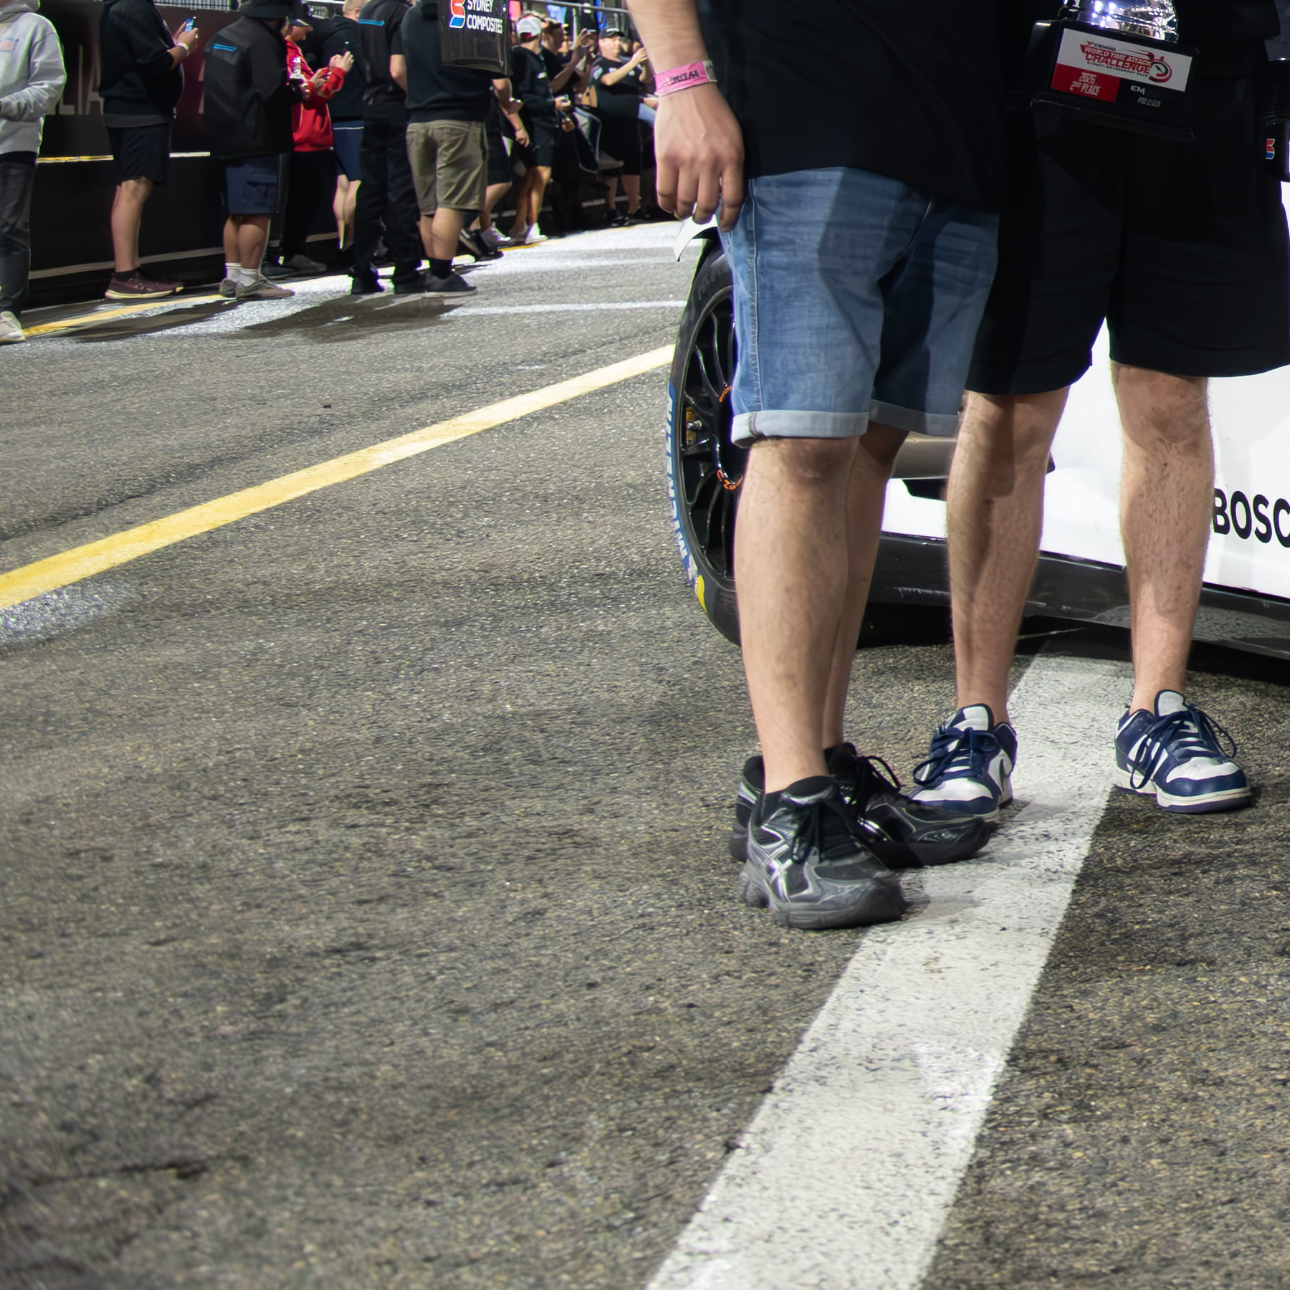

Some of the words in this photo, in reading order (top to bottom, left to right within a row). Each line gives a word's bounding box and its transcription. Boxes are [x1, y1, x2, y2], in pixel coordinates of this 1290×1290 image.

[466, 14, 503, 34] COMPOSITES
[1084, 46, 1110, 57] WORLD
[1080, 82, 1102, 97] PLACE
